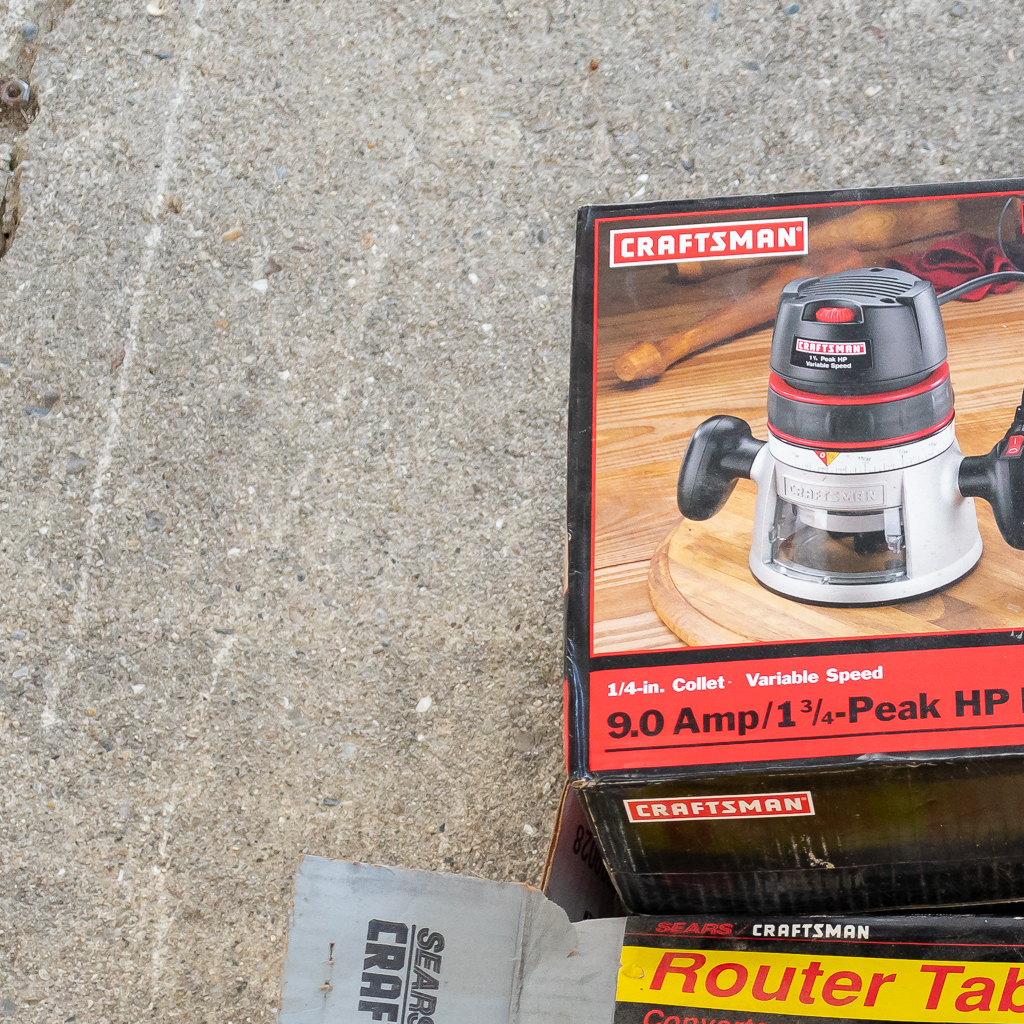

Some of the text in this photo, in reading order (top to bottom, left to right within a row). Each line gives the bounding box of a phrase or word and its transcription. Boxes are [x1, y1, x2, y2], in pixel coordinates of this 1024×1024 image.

[621, 227, 795, 258] CRAFTSMAN
[799, 341, 860, 353] CRAFTSMAN
[790, 484, 877, 501] CRAFTSMAN
[608, 666, 883, 697] 1/4-in. Collet Variable Speed
[607, 709, 665, 739] 9.0
[955, 689, 1010, 717] HP
[636, 798, 802, 817] CRAFTSMAN
[655, 921, 870, 940] SEARS CRAFTSMAN
[649, 952, 896, 1008] Router
